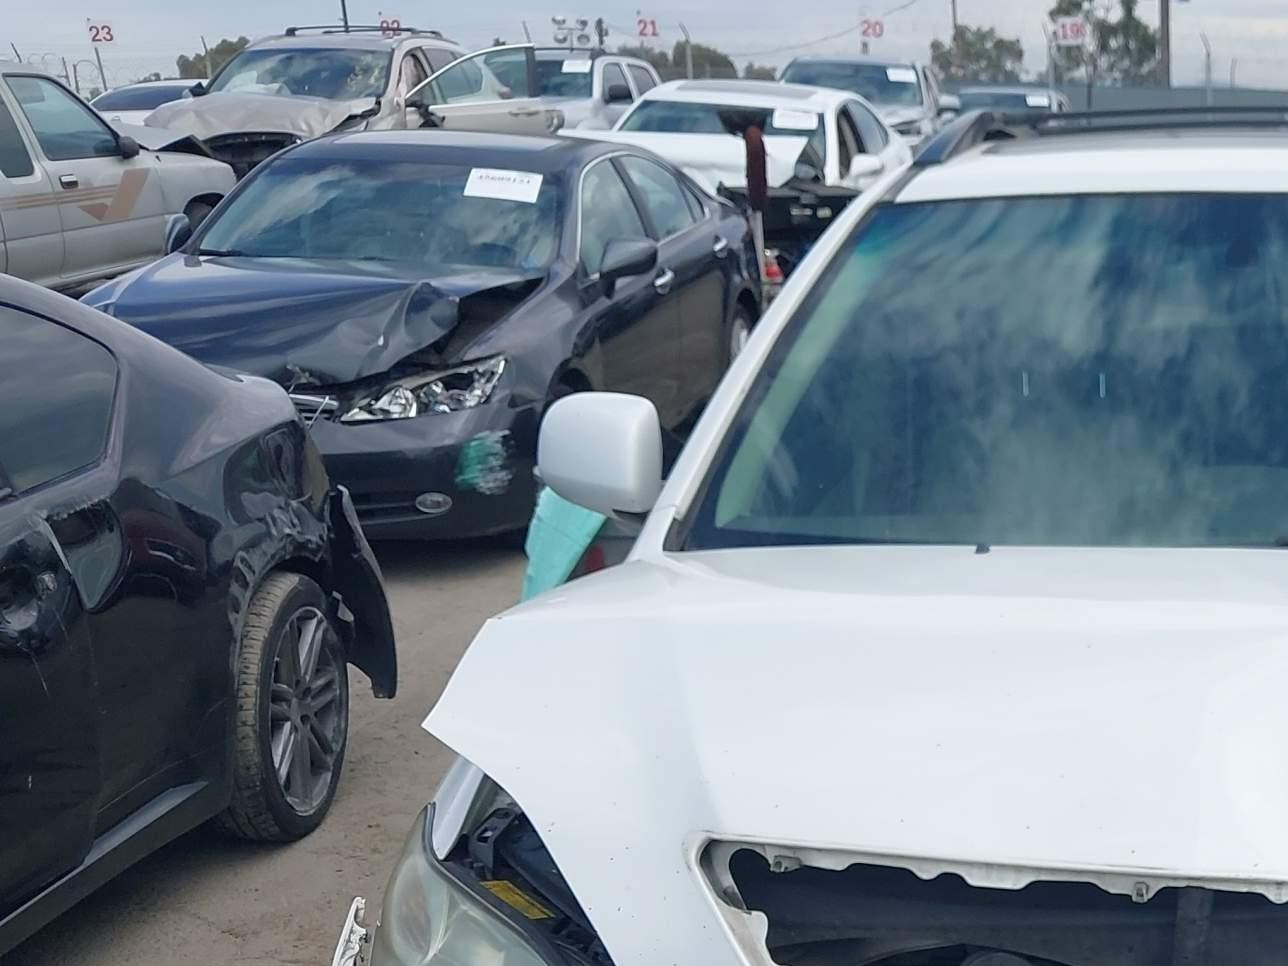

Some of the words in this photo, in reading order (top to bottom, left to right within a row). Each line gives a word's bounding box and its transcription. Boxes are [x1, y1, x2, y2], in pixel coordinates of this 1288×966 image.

[88, 25, 114, 42] 23
[638, 19, 659, 36] 21
[862, 20, 885, 38] 20
